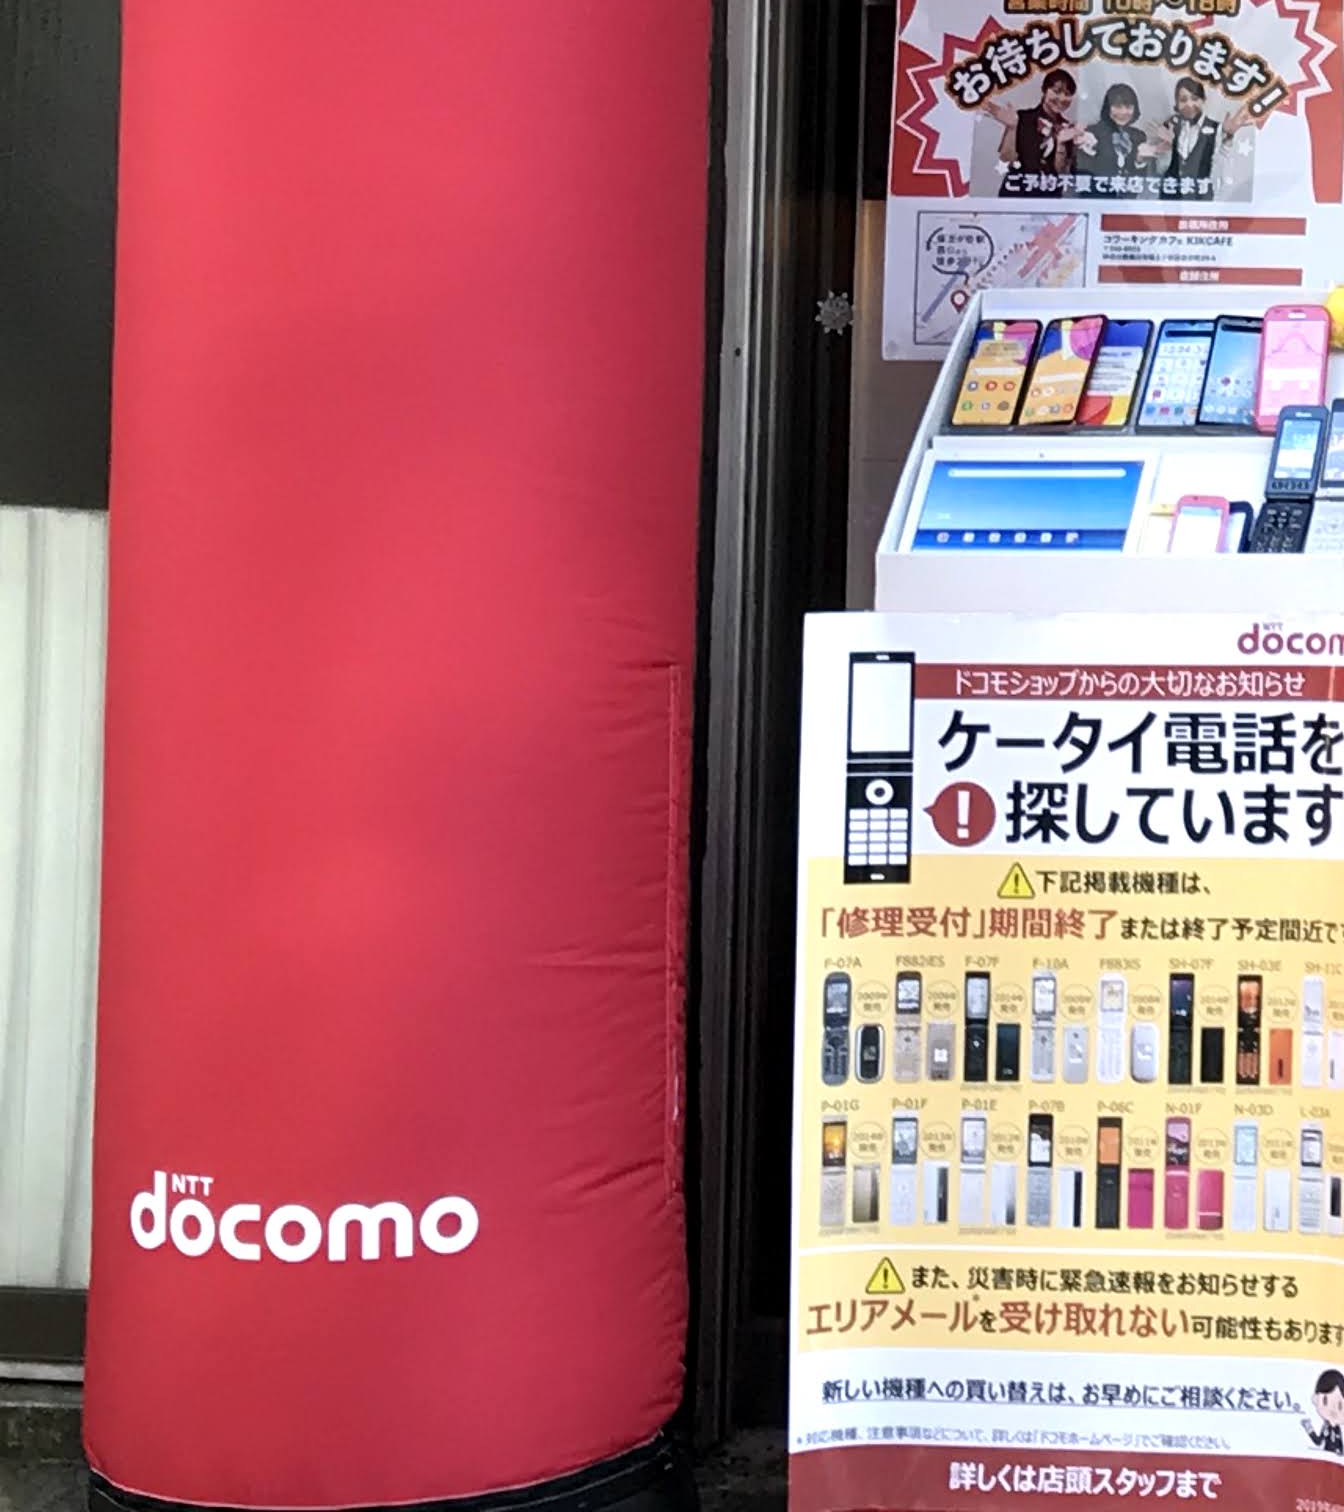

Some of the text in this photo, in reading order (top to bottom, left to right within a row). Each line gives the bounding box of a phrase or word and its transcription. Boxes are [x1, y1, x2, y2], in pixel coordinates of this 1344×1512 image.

[954, 670, 1306, 699] ドコモショップからの大切なお知らせ
[937, 709, 1344, 776] ケータイ電話を
[1005, 782, 1344, 847] 探しています
[1036, 870, 1212, 896] 下記掲載機種は、
[171, 1173, 214, 1197] NTT
[130, 1170, 480, 1263] docomo
[910, 1267, 1299, 1300] また、災害時に緊急速報をお知らせする
[948, 1461, 1224, 1500] 詳しくは店頭スタッフまで
